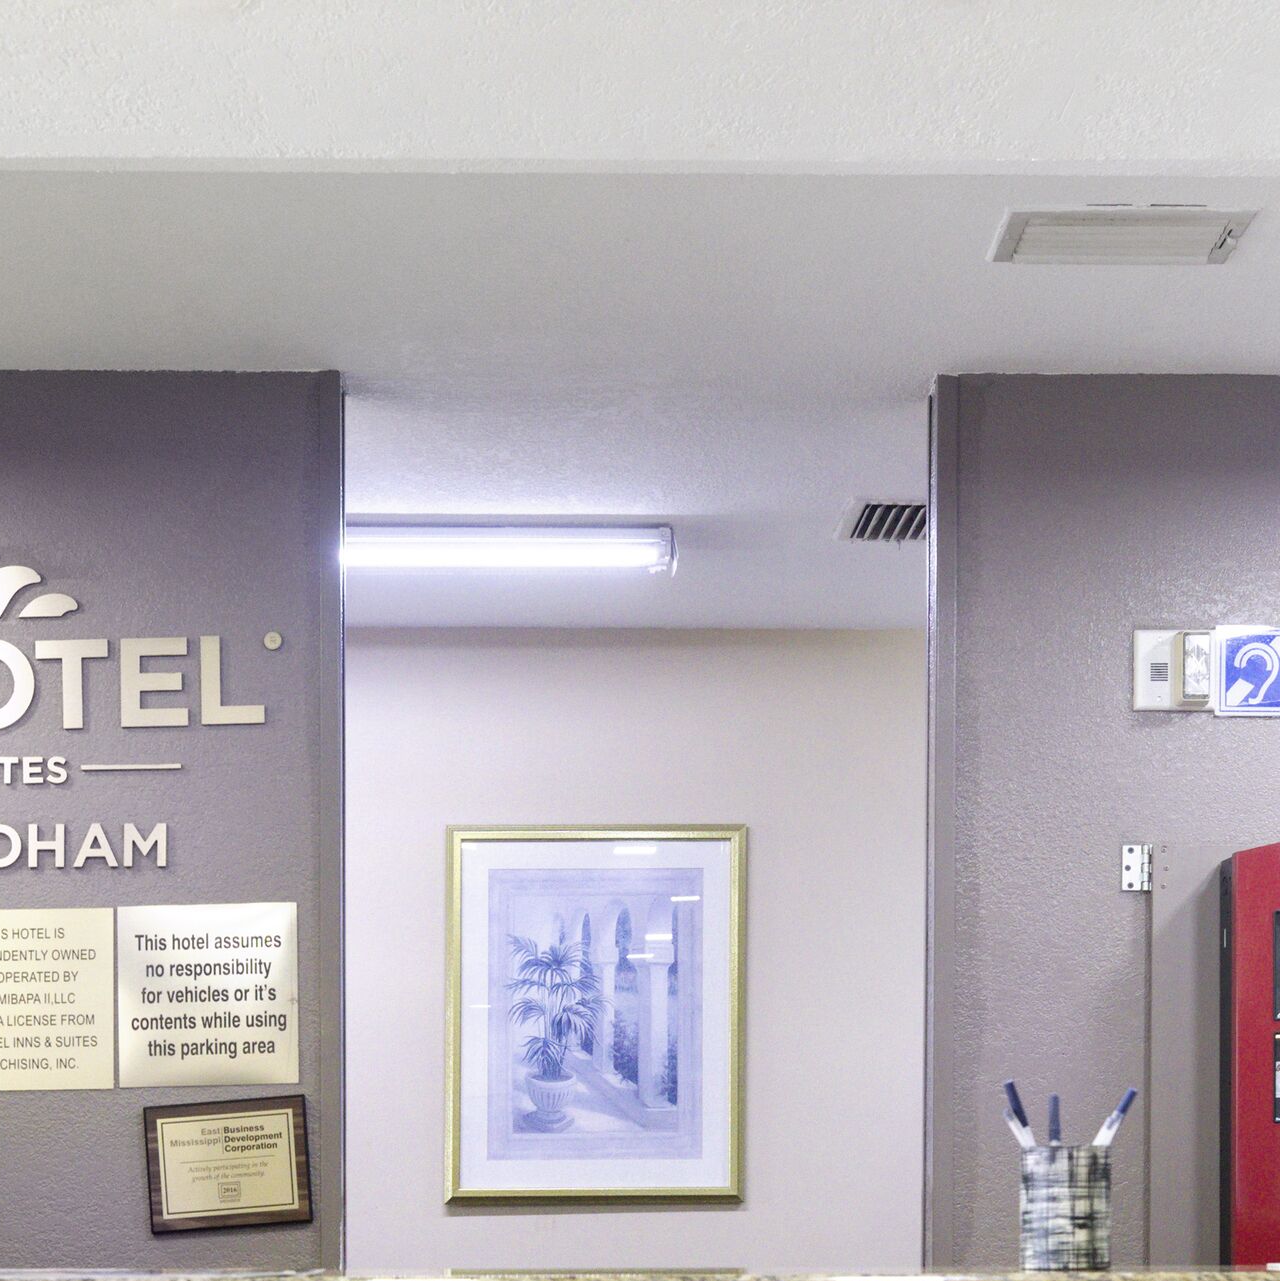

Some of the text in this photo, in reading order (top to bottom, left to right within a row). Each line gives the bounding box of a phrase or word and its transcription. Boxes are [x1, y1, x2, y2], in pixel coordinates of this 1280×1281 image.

[11, 927, 51, 940] HOTEL
[54, 927, 65, 939] IS
[135, 933, 282, 951] This hotel assumes
[51, 949, 97, 961] OWNED
[145, 958, 272, 981] no responsibility
[63, 970, 79, 982] BY
[141, 984, 277, 1004] for vehicles or it's
[7, 1014, 57, 1027] LICENSE
[60, 1014, 95, 1025] FROM
[131, 1010, 287, 1031] contents while using
[13, 1036, 41, 1048] INNS
[44, 1036, 52, 1048] &
[55, 1035, 98, 1047] SUITES
[147, 1038, 275, 1060] this parking area
[56, 1057, 79, 1069] INC.
[201, 1127, 220, 1136] East
[223, 1124, 265, 1134] Business
[170, 1137, 221, 1148] Mississippi
[224, 1132, 282, 1143] Development
[224, 1142, 278, 1154] Corporation
